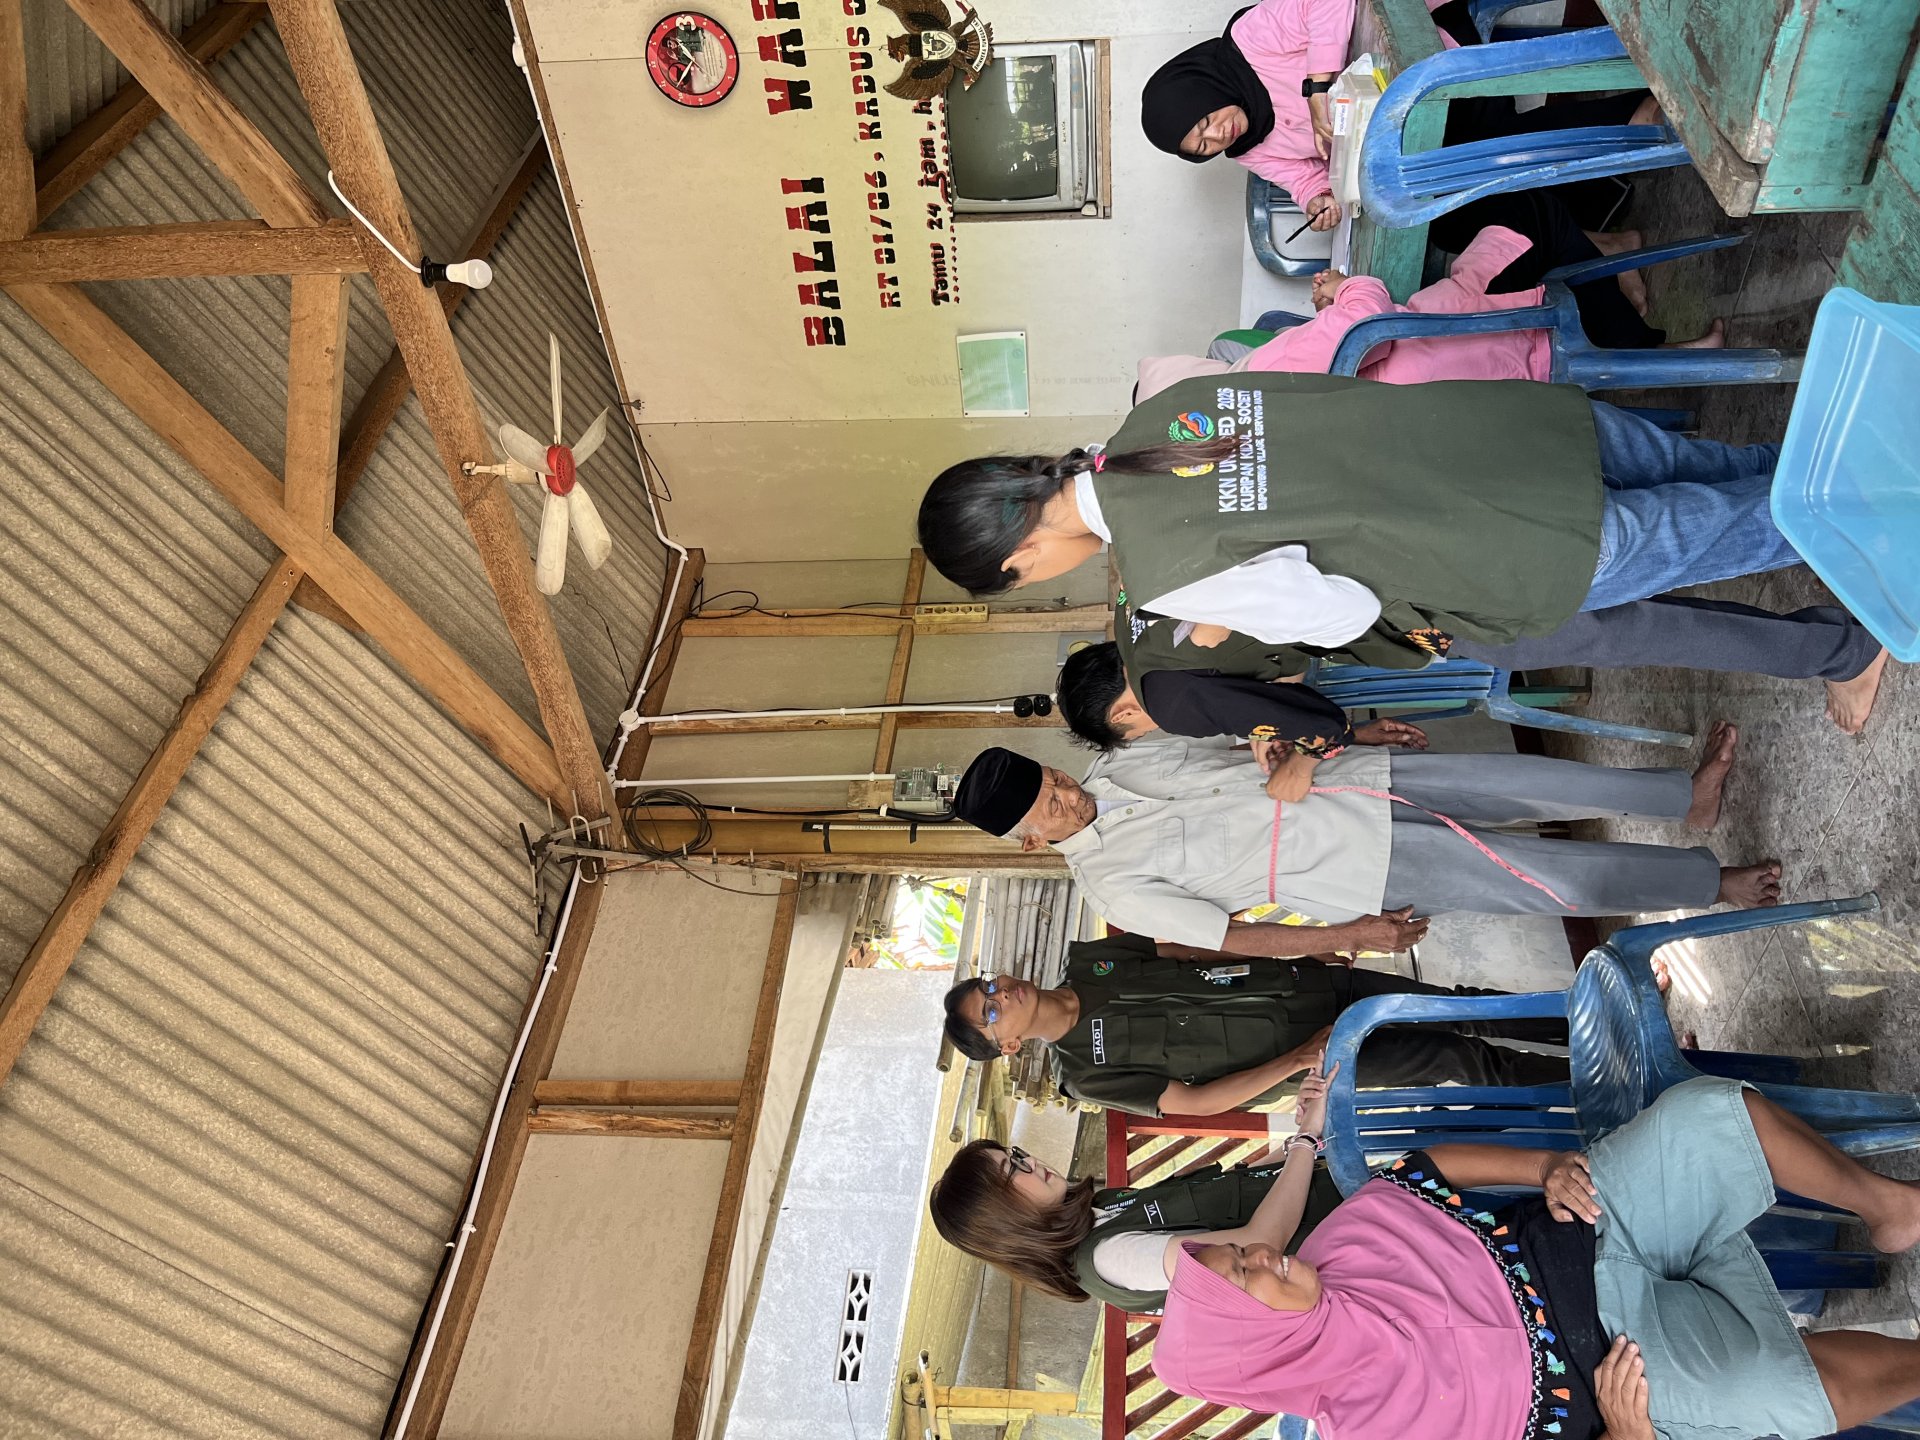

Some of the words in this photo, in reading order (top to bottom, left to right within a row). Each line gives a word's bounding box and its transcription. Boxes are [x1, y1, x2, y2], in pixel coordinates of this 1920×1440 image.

[676, 15, 696, 30] 3
[846, 26, 882, 141] KADUS
[926, 202, 944, 230] 24
[780, 177, 846, 346] BALAI
[930, 242, 950, 306] Tamu
[877, 272, 901, 308] RT
[1217, 387, 1235, 410] 2026
[1254, 406, 1264, 436] SERVING
[1218, 416, 1237, 473] UNED
[1239, 430, 1254, 459] KIDUL
[1218, 478, 1237, 512] KKN
[1240, 463, 1255, 511] KURIPAN
[1094, 1028, 1102, 1054] HADI
